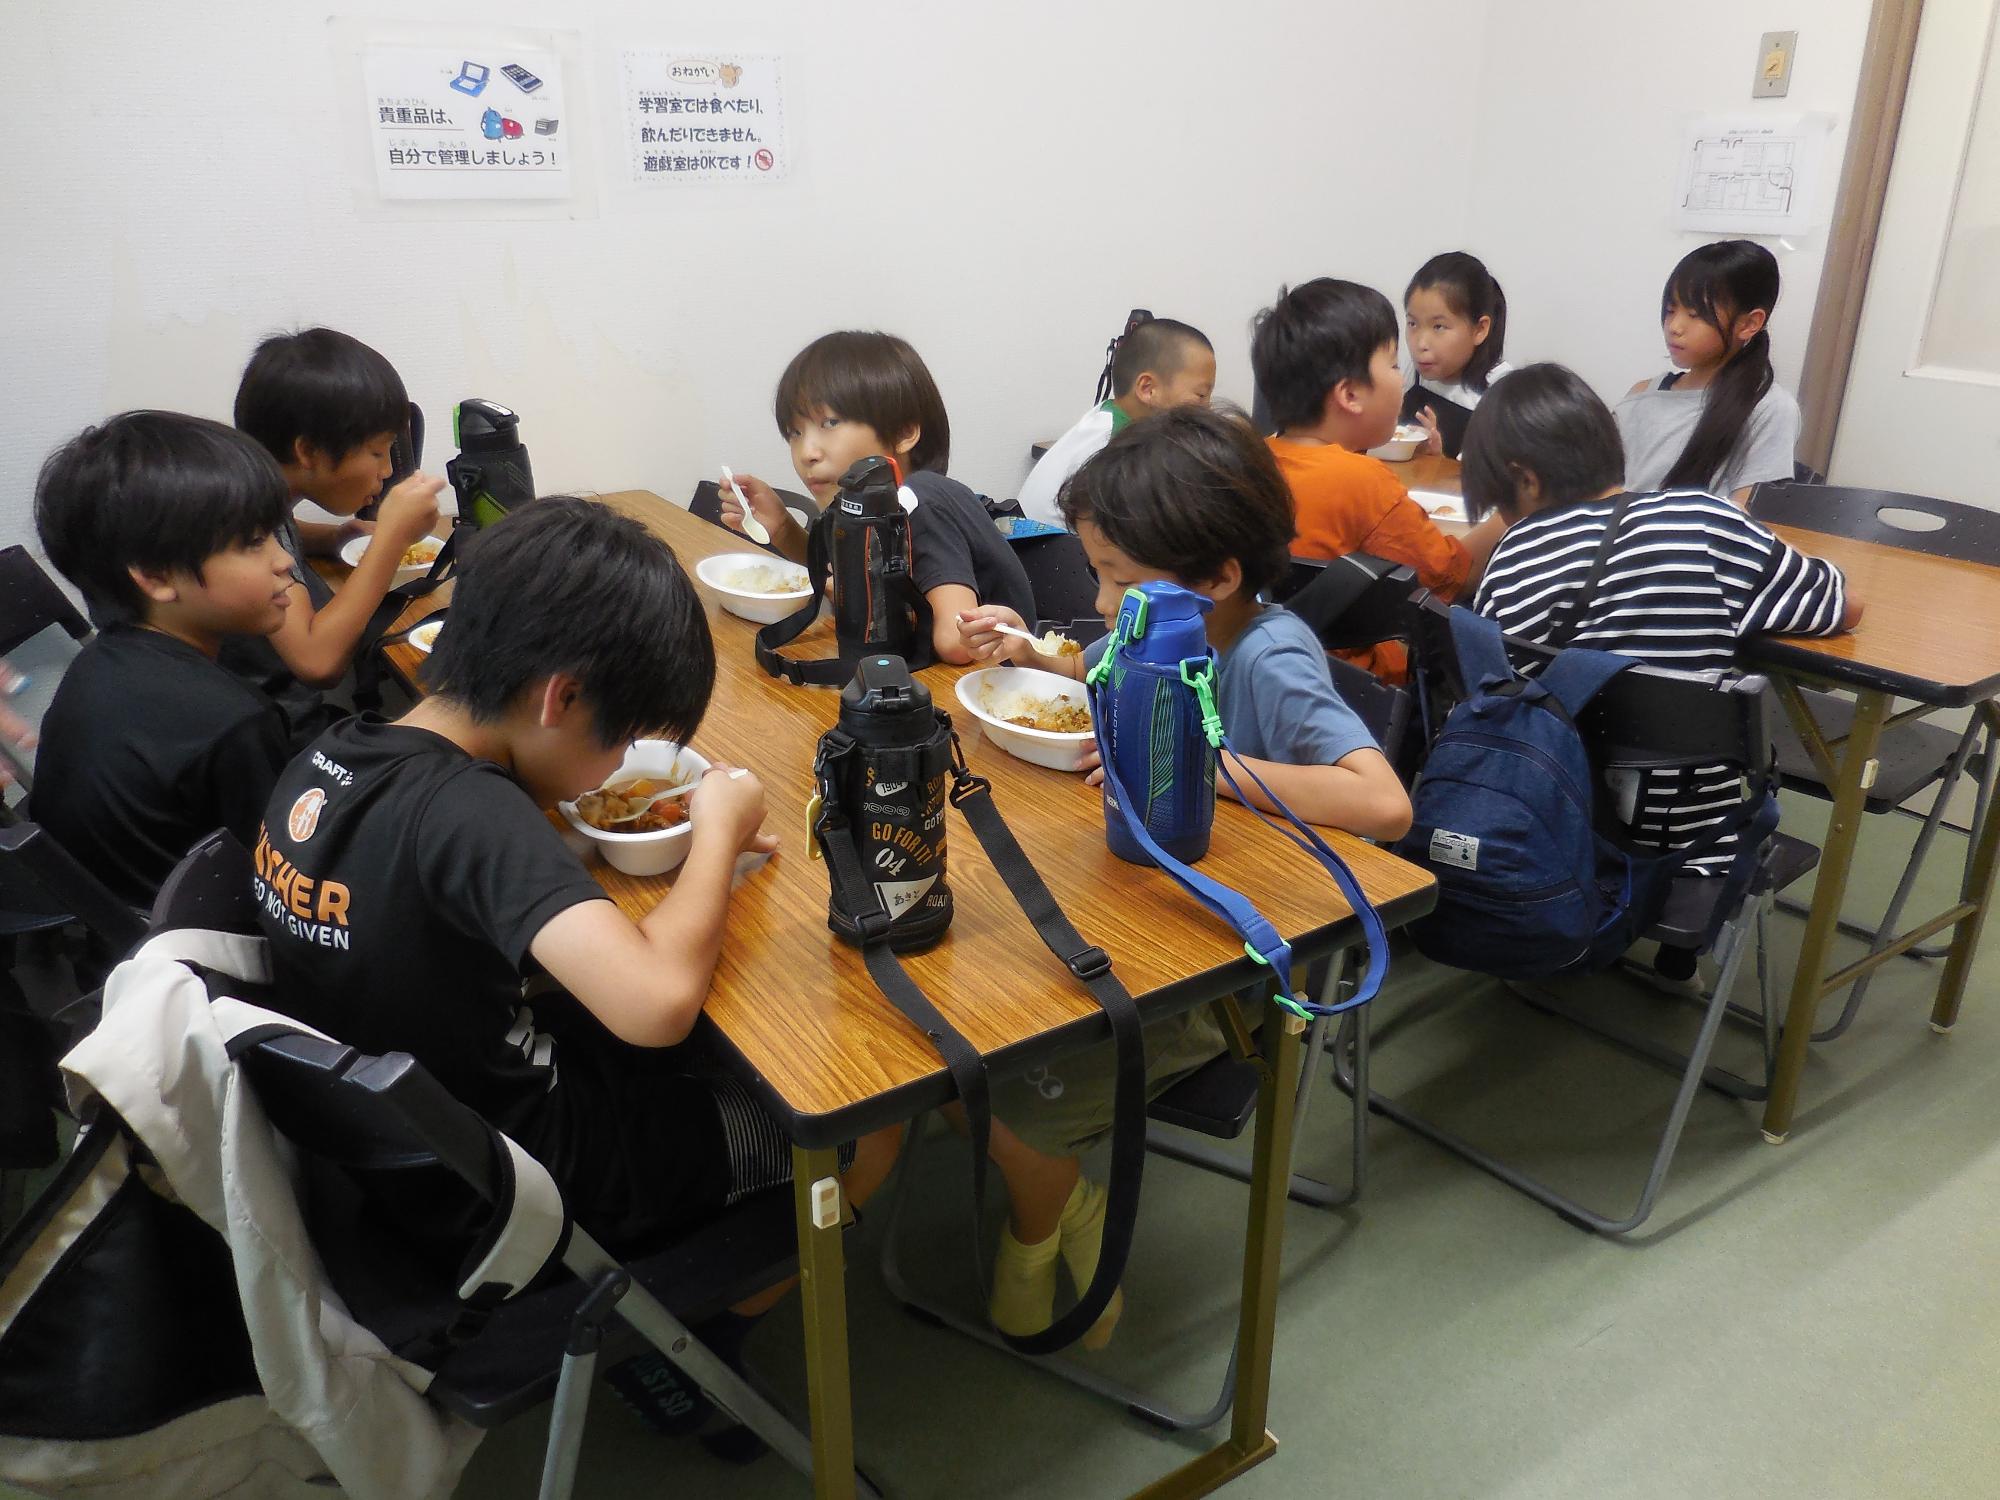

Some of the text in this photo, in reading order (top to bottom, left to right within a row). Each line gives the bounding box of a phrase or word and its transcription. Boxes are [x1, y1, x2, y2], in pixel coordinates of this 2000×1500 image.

[671, 66, 715, 77] おねがい
[639, 97, 764, 114] 学習室では食べたり、
[379, 106, 454, 124] 貴重品は、
[641, 127, 762, 143] 飲んだりできません。
[389, 148, 557, 165] 自分で管理しましょう！
[643, 156, 752, 172] 遊戯室はOKです！
[312, 751, 348, 780] CRAFT
[872, 822, 892, 841] GO
[893, 826, 921, 853] FOR
[875, 847, 906, 876] 04
[265, 890, 287, 925] NOT
[287, 914, 350, 950] GIVEN
